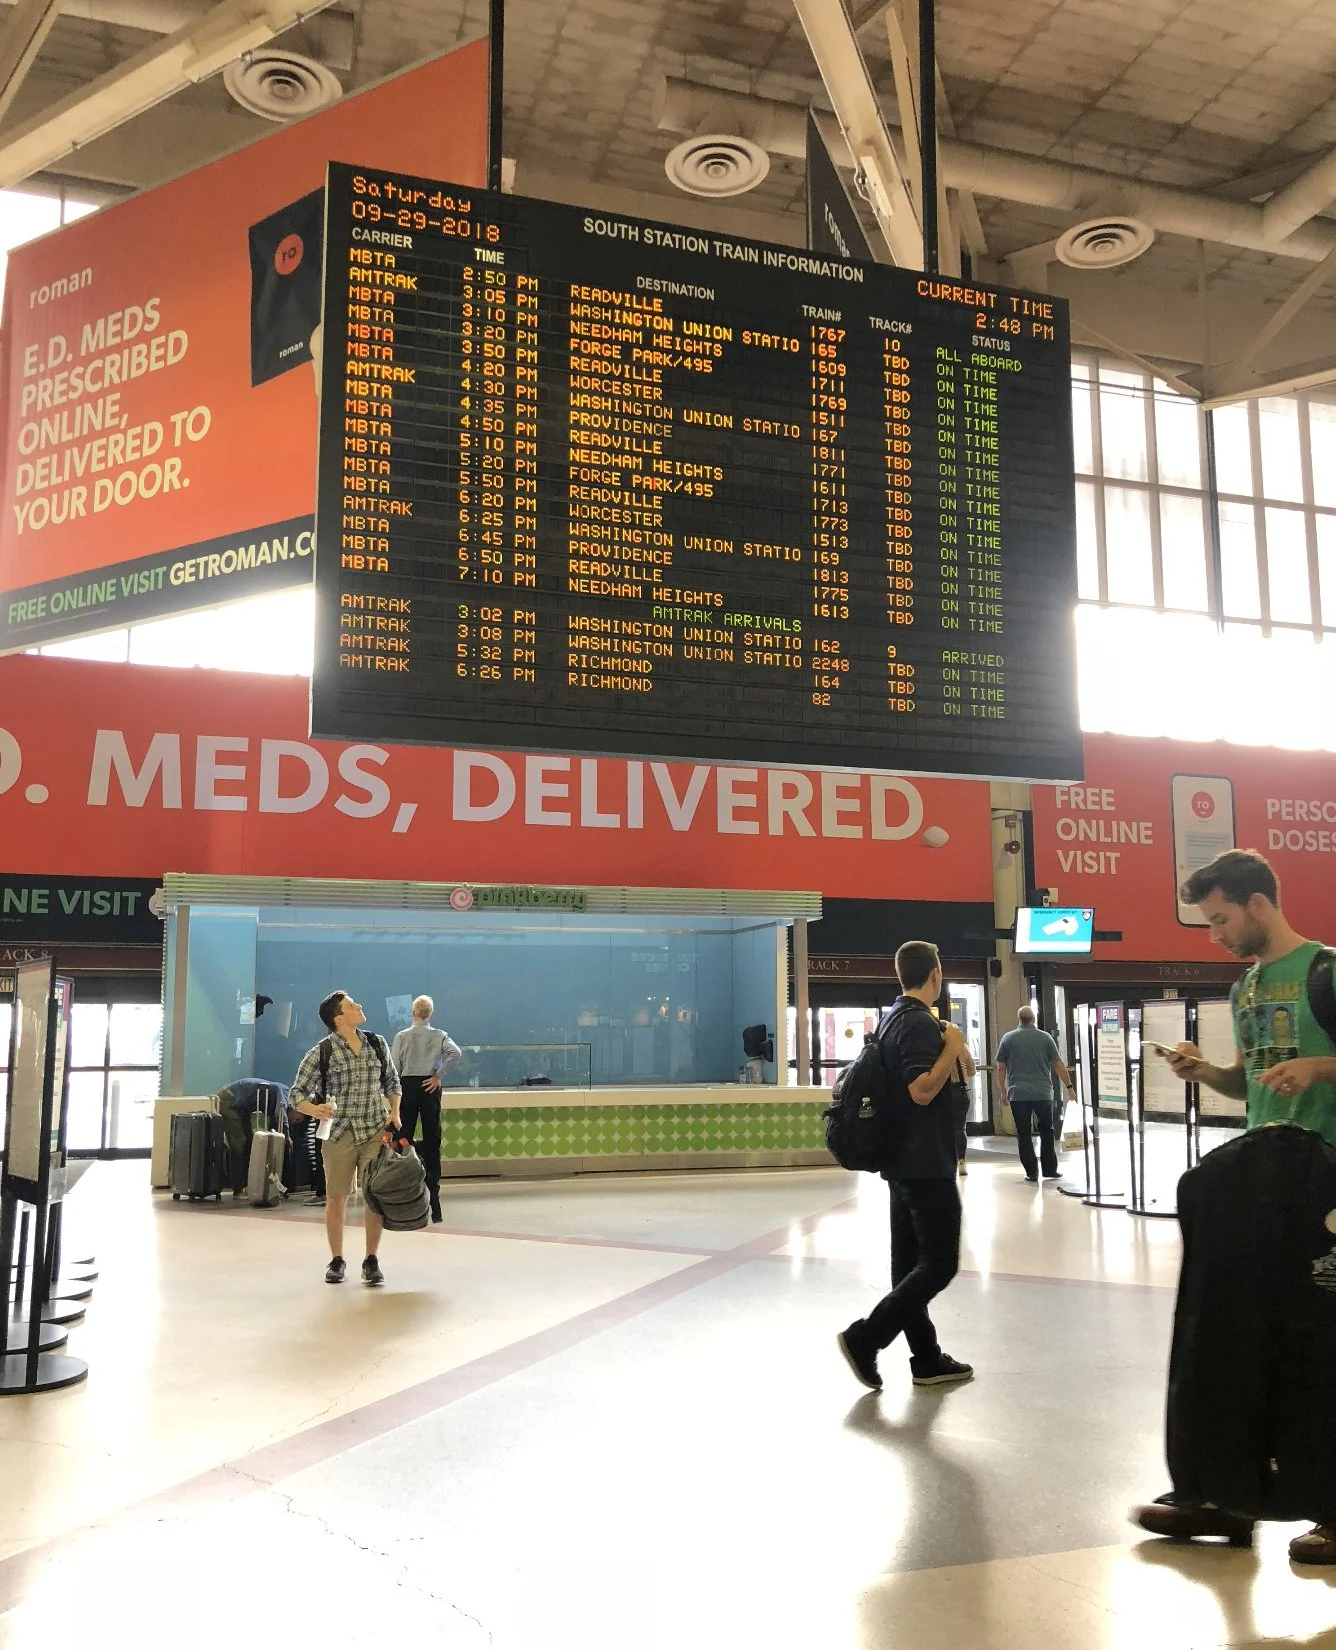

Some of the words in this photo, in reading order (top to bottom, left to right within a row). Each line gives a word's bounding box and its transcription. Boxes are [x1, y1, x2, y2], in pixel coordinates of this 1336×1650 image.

[351, 200, 500, 243] 09-29-2018
[352, 175, 471, 213] Saturday
[281, 246, 298, 264] ro
[583, 217, 639, 242] SOUTH
[642, 228, 709, 256] STATION
[712, 240, 759, 264] TRAIN
[762, 248, 865, 283] INFORMATION
[29, 267, 92, 309] roman
[348, 247, 396, 268] MBTA
[462, 266, 506, 286] 2:50
[516, 274, 538, 292] PM
[570, 283, 663, 313] READVILLE
[810, 324, 846, 343] 1767
[884, 337, 901, 352] 10
[936, 346, 962, 363] ALL
[971, 352, 1022, 372] ABOARD
[351, 226, 413, 249] CARRIER
[473, 247, 505, 265] TIME
[636, 275, 715, 301] DESTINATION
[801, 304, 842, 322] TRAIN#
[868, 315, 912, 335] TRACK#
[971, 334, 1011, 352] STATUS
[916, 279, 997, 308] CURRENT
[1009, 296, 1054, 320] TIME
[23, 332, 73, 377] E.D.
[81, 297, 161, 353] MEDS
[279, 341, 304, 359] roman
[347, 284, 395, 306] MBTA
[462, 302, 506, 323] 3:10
[516, 311, 538, 328] PM
[569, 319, 643, 345] NEEDHAM
[652, 333, 723, 357] HEIGHTS
[810, 358, 847, 377] 1609
[883, 370, 910, 387] TBD
[936, 379, 955, 394] ON
[963, 383, 997, 401] TIME
[348, 266, 418, 291] AMTRAK
[462, 284, 506, 305] 3:05
[516, 293, 538, 310] PM
[569, 301, 673, 332] WASHINGTON
[682, 320, 733, 342] UNION
[742, 330, 800, 353] STATIO
[809, 341, 837, 358] 165
[882, 353, 910, 370] TBD
[936, 363, 954, 377] ON
[962, 367, 997, 385] TIME
[975, 311, 1021, 335] 2:48
[1031, 322, 1054, 341] PM
[20, 330, 189, 417] PRESCRIBED
[346, 303, 394, 324] MBTA
[460, 320, 505, 341] 3:20
[516, 329, 538, 346] PM
[568, 337, 622, 359] FORGE
[631, 347, 713, 374] PARK/495
[811, 375, 844, 394] 1711
[883, 387, 911, 404] TBD
[937, 396, 955, 410] ON
[963, 400, 998, 417] TIME
[16, 420, 164, 496] DELIVERED
[170, 405, 212, 447] TO
[18, 392, 129, 455] ONLINE,
[345, 378, 393, 400] MBTA
[459, 395, 505, 414] 4:35
[515, 402, 537, 419] PM
[569, 410, 673, 438] PROVIDENCE
[812, 444, 845, 462] 1811
[884, 455, 912, 471] TBD
[939, 463, 956, 477] ON
[965, 466, 999, 483] TIME
[13, 490, 87, 534] YOUR
[93, 457, 190, 513] DOOR.
[343, 475, 390, 494] MBTA
[458, 488, 504, 508] 6:20
[513, 495, 537, 512] PM
[569, 502, 663, 527] WORCESTER
[812, 532, 849, 549] 1513
[885, 540, 913, 556] TBD
[940, 547, 958, 561] ON
[967, 550, 1002, 566] TIME
[343, 494, 413, 516] AMTRAK
[458, 508, 504, 527] 6:25
[514, 514, 537, 531] PM
[569, 521, 673, 547] WASHINGTON
[683, 535, 733, 554] UNION
[743, 542, 801, 561] STATIO
[813, 550, 840, 566] 169
[885, 558, 913, 573] TBD
[940, 564, 958, 578] ON
[967, 567, 1002, 583] TIME
[7, 593, 46, 625] FREE
[49, 578, 117, 613] ONLINE
[120, 567, 167, 598] VISIT
[340, 553, 389, 572] MBTA
[458, 565, 503, 584] 7:10
[513, 571, 536, 588] PM
[568, 577, 642, 599] NEEDHAM
[652, 586, 723, 607] HEIGHTS
[813, 603, 849, 619] 1613
[886, 609, 914, 625] TBD
[941, 616, 959, 629] ON
[968, 618, 1003, 633] TIME
[652, 605, 713, 624] AMTRAK
[723, 612, 801, 632] ARRIVALS
[340, 593, 412, 613] AMTRAK
[458, 604, 502, 622] 3:02
[512, 609, 535, 625] PM
[568, 615, 673, 639] WASHINGTON
[683, 626, 734, 644] UNION
[743, 632, 802, 650] STATIO
[813, 638, 840, 654] 162
[886, 644, 897, 658] 9
[942, 650, 1004, 667] ARRIVED
[339, 633, 411, 652] AMTRAK
[456, 642, 502, 660] 5:32
[512, 647, 535, 663] PM
[567, 652, 653, 673] RICHMOND
[814, 674, 840, 689] 164
[887, 680, 915, 695] TBD
[943, 685, 960, 698] ON
[970, 687, 1005, 702] TIME
[86, 729, 419, 834] MEDS,
[1055, 785, 1116, 812] FREE
[1055, 818, 1154, 845] ONLINE
[1056, 850, 1121, 876] VISIT
[1267, 828, 1336, 853] DOSE
[2, 888, 49, 914] NE
[57, 889, 142, 916] VISIT
[478, 886, 587, 913] pinkberry
[844, 961, 850, 971] 7
[1157, 966, 1192, 976] TRACK
